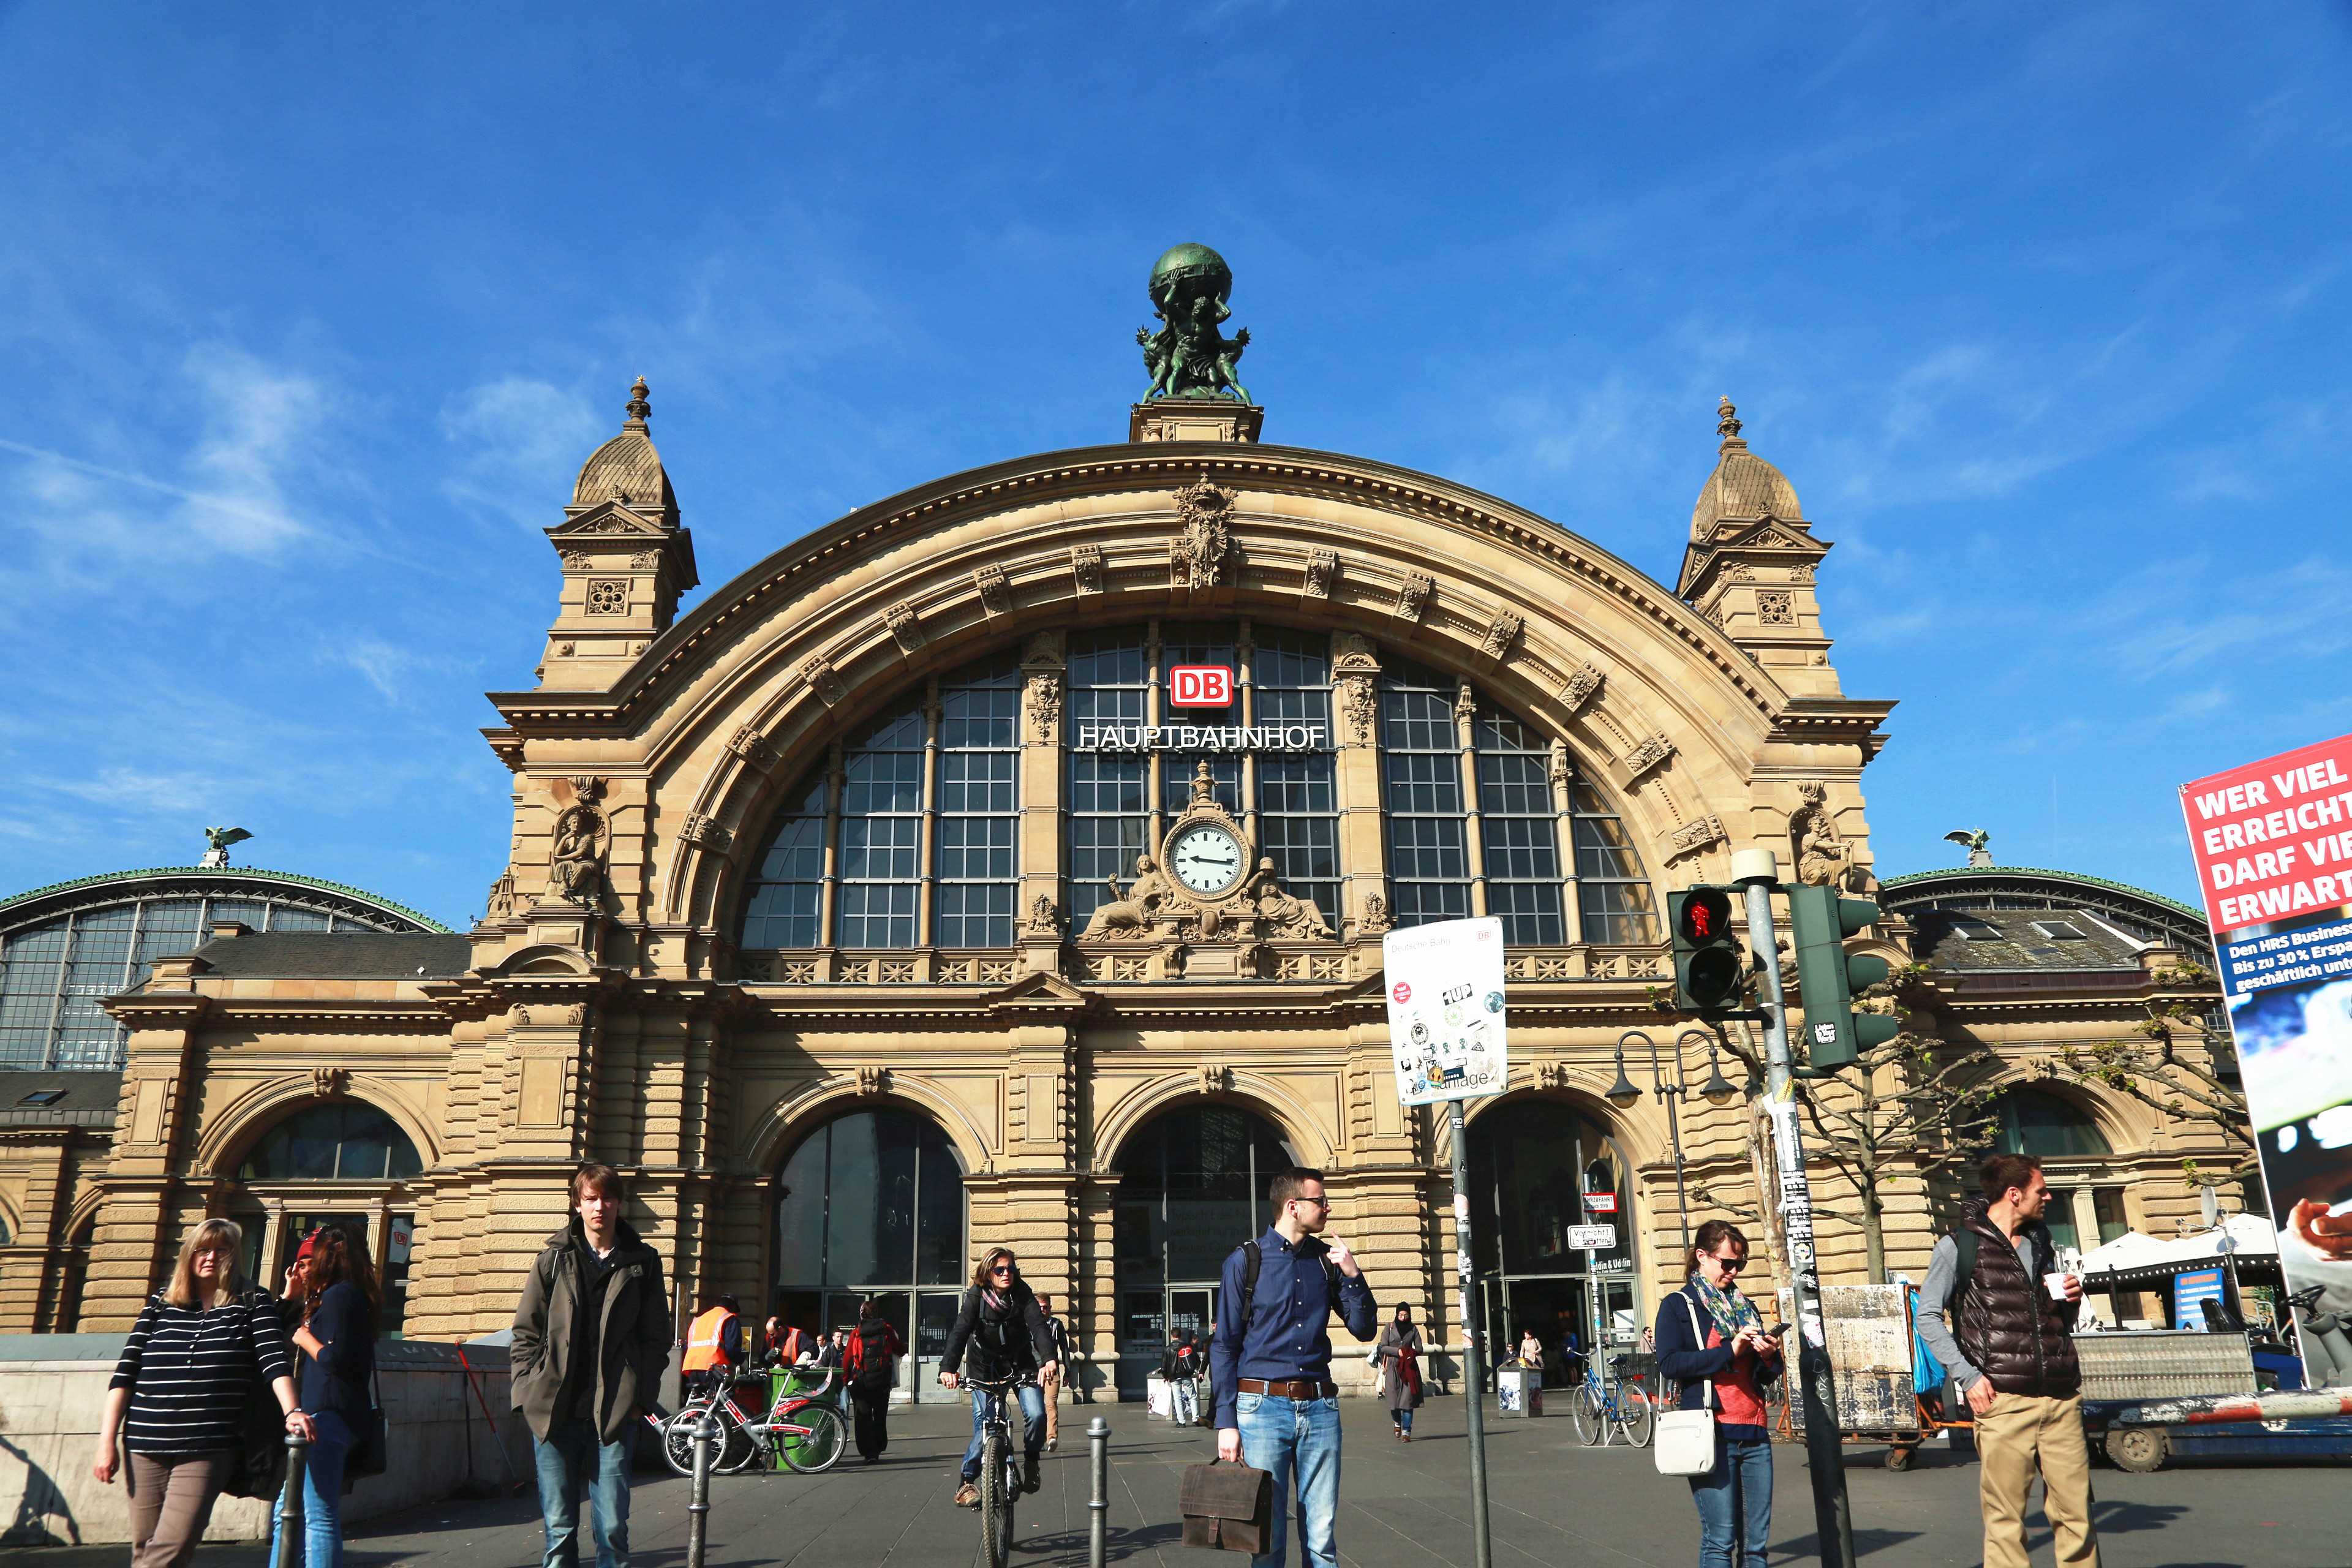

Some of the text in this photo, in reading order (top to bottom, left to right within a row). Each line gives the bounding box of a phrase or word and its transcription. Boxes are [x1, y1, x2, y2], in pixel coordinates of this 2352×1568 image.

[1179, 673, 1224, 699] DB
[1079, 725, 1325, 748] HAUPTBAHNHOF
[2194, 758, 2348, 821] WER VIEL
[2203, 791, 2352, 856] ERREICHT
[2211, 845, 2296, 891] DARF
[2218, 870, 2352, 926] ERWART
[1392, 938, 1451, 953] Deutsche Bahn
[2229, 943, 2258, 959] Den
[2260, 935, 2290, 952] HRS
[2233, 959, 2256, 976] Bis
[2257, 956, 2275, 970] zu
[2236, 964, 2323, 993] geschäftlich
[1444, 984, 1471, 1004] 1UP
[1816, 1034, 1836, 1043] World
[1171, 1209, 1207, 1223] Typisch
[1170, 1226, 1210, 1237] verkehrt
[1170, 1241, 1206, 1254] besten
[1607, 1261, 1613, 1269] &
[1613, 1258, 1631, 1268] Uddin
